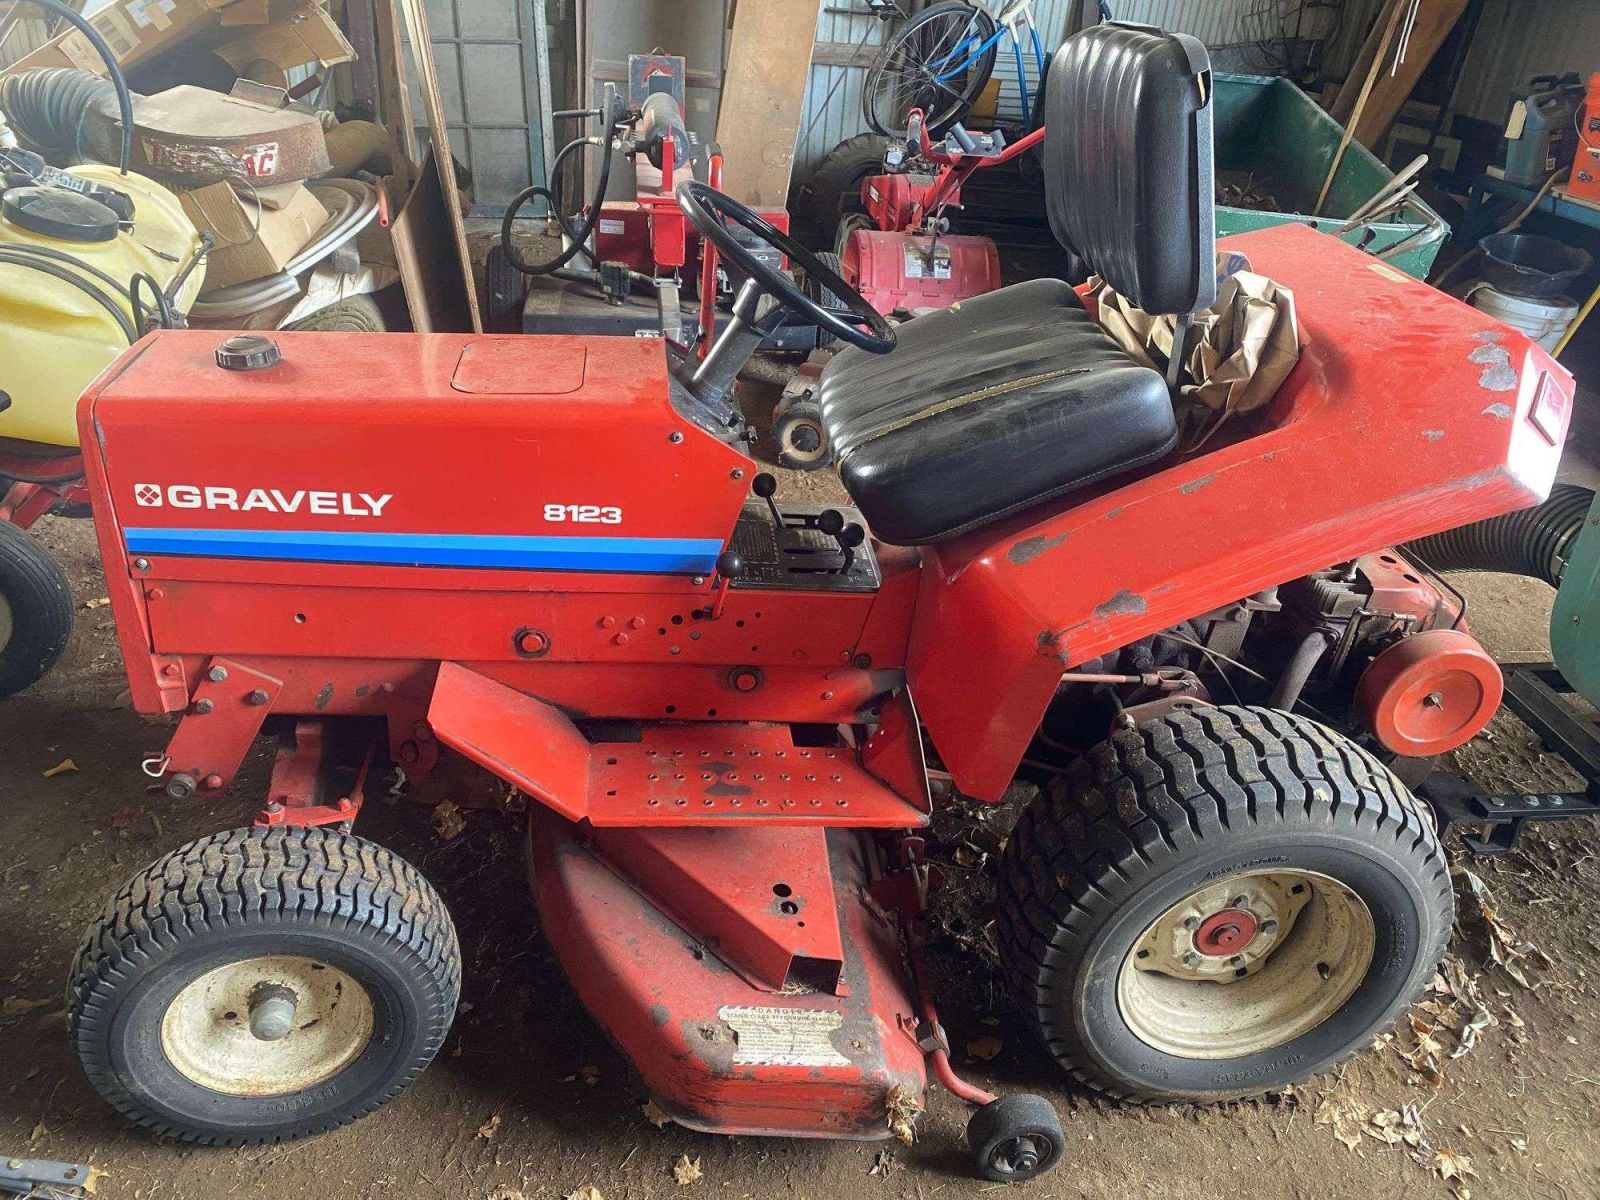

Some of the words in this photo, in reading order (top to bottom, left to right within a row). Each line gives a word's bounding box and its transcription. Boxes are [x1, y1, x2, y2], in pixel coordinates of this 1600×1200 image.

[167, 484, 393, 517] GRAVELY
[543, 504, 622, 524] 8123
[758, 1007, 802, 1015] DANGER
